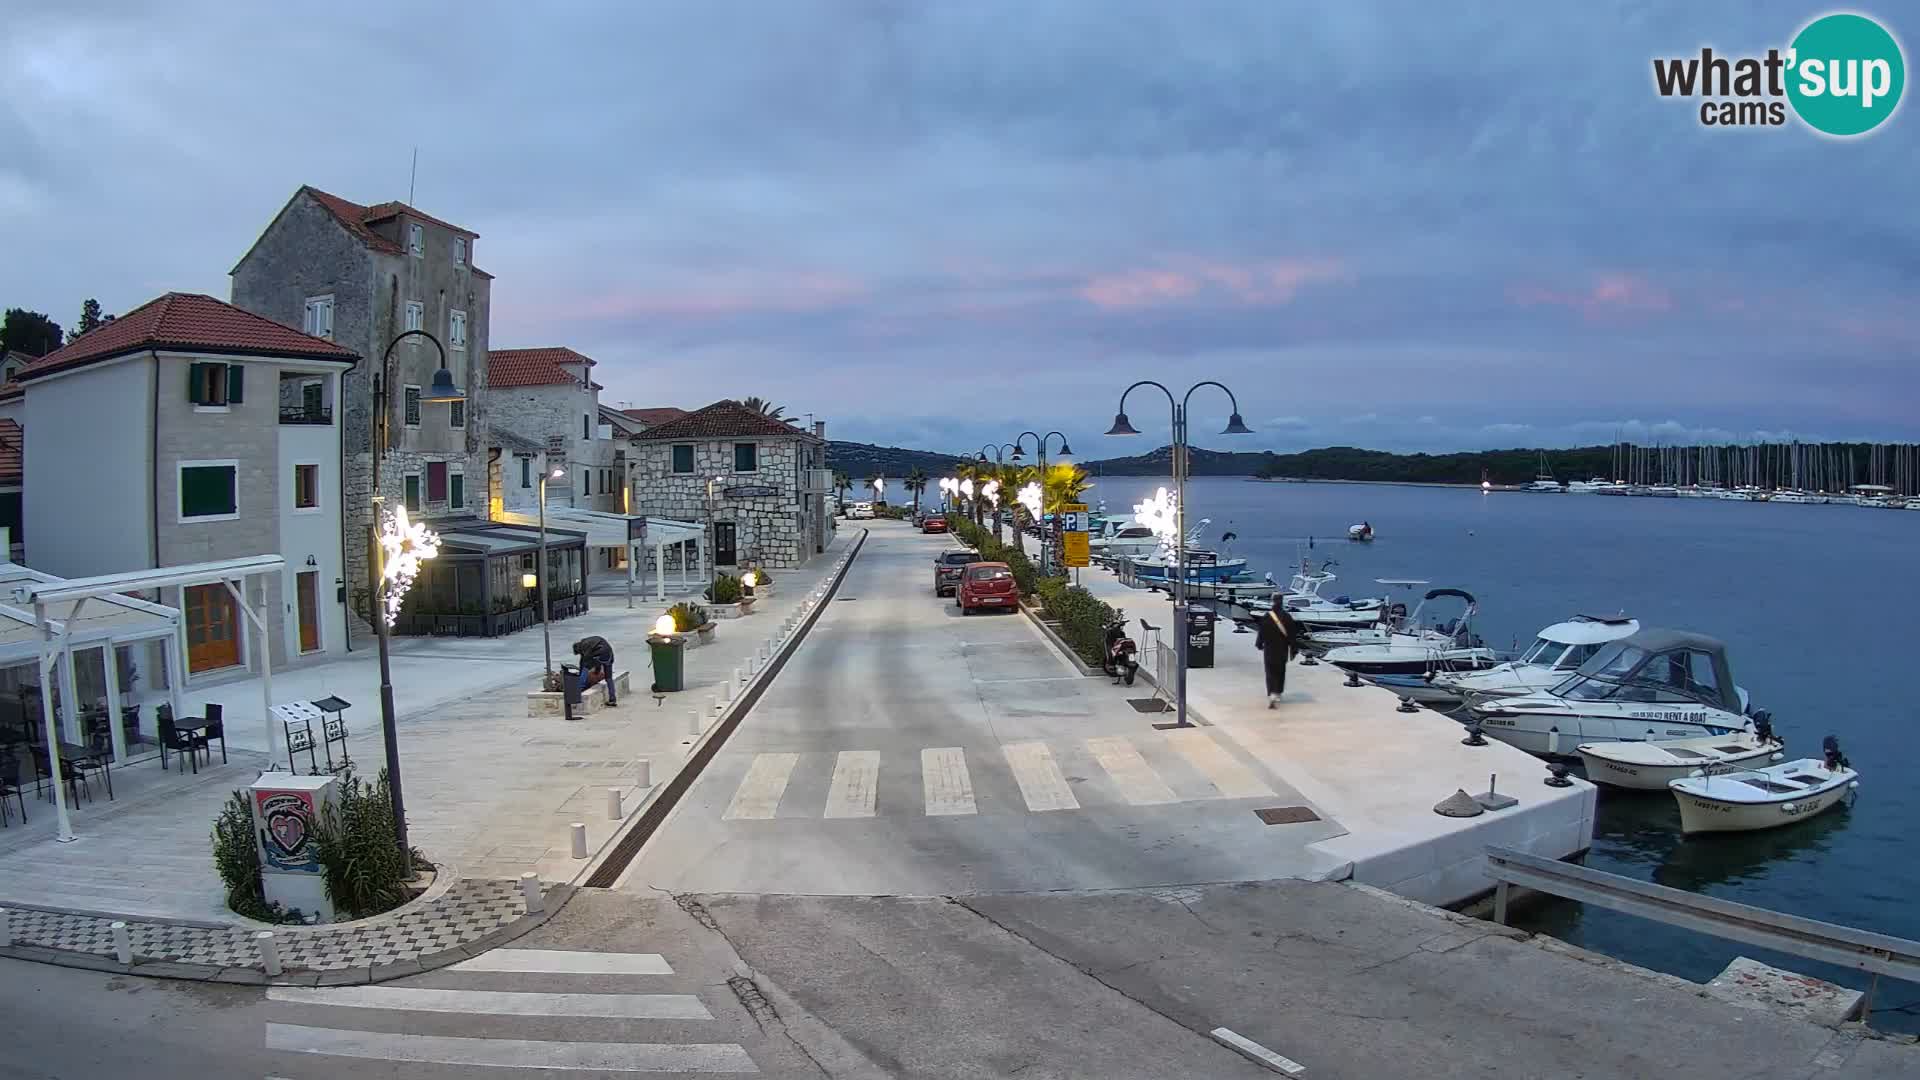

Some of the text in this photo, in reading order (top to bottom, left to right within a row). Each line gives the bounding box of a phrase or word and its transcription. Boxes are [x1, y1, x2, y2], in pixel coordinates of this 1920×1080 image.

[1066, 514, 1076, 530] P
[1663, 712, 1683, 720] RENT
[1689, 712, 1707, 723] BOAT
